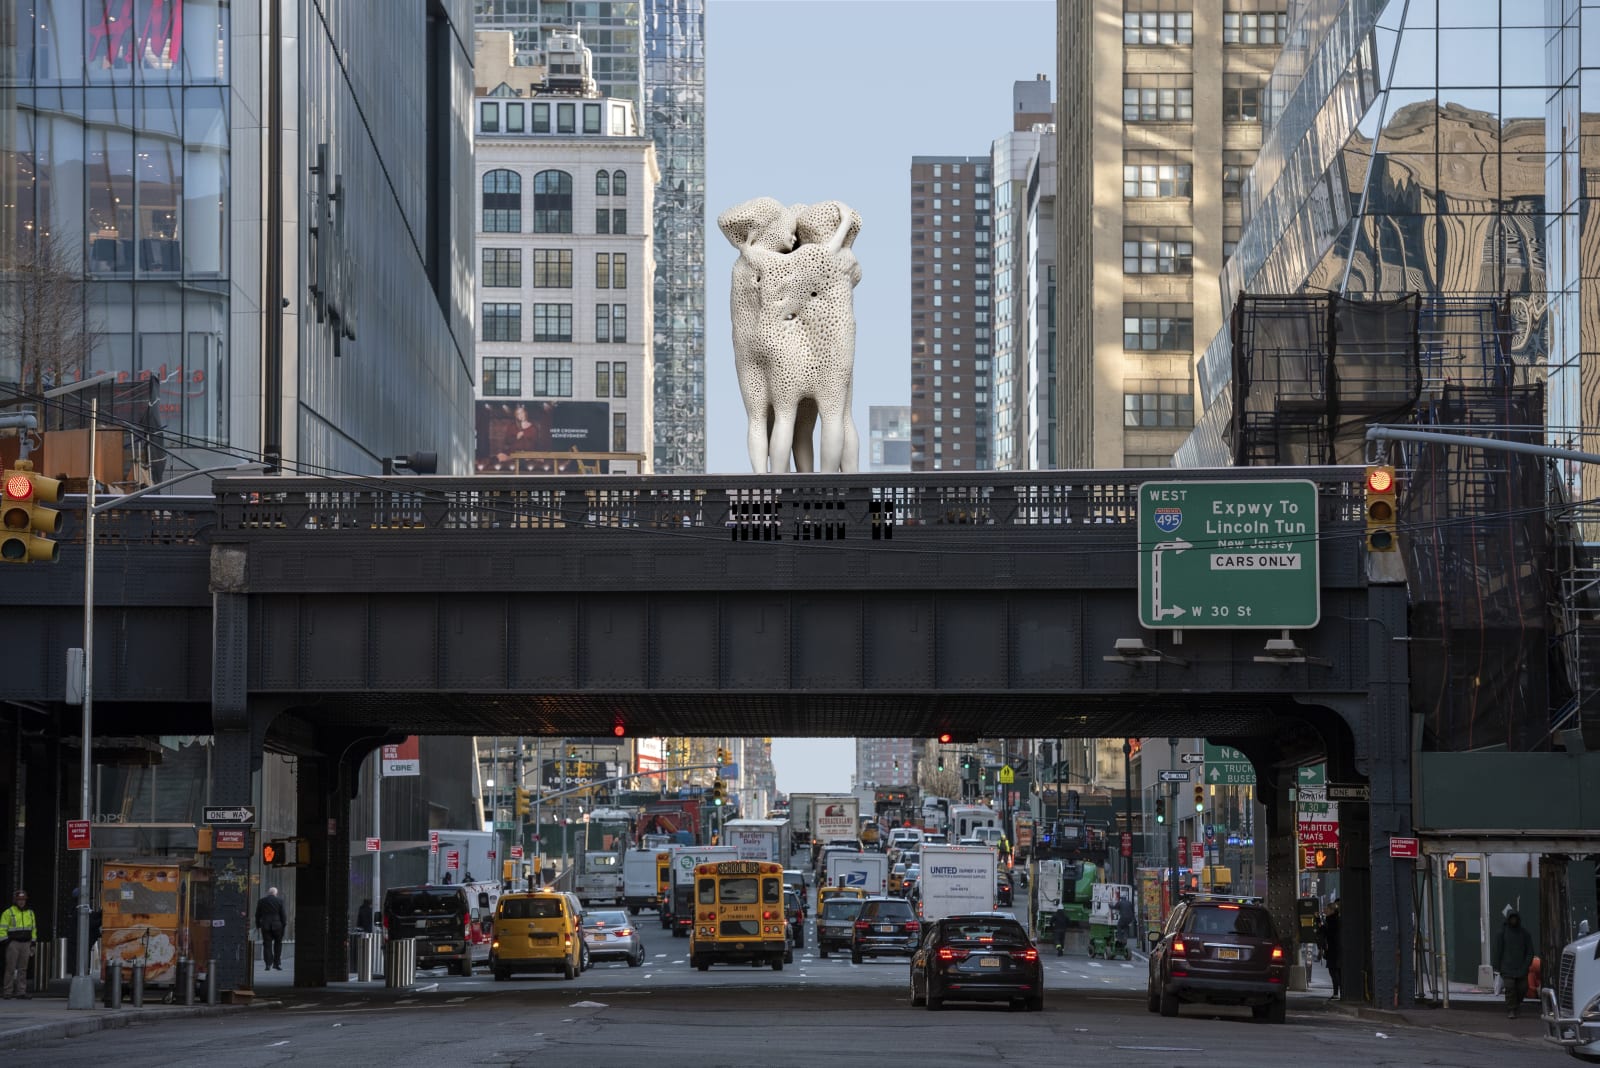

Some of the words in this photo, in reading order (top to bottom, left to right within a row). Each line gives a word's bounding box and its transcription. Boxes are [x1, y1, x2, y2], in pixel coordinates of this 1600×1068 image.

[1150, 491, 1187, 500] WEST
[1213, 501, 1272, 517] Expwy
[1280, 501, 1298, 513] To
[1157, 514, 1179, 525] 495
[1207, 520, 1268, 534] Lincoln
[1275, 520, 1306, 534] Tun
[1218, 539, 1244, 549] New
[1250, 539, 1293, 551] Jersey
[1216, 556, 1254, 567] CARS
[1259, 556, 1295, 567] ONLY
[1192, 606, 1202, 617] W
[1211, 606, 1229, 617] 30
[1237, 606, 1252, 617] St
[1224, 765, 1256, 773] TRUCK
[1228, 775, 1256, 783] BUSES
[1334, 788, 1349, 796] ONE
[1308, 803, 1319, 811] 30
[211, 811, 226, 819] ONE
[232, 811, 248, 819] WAY
[718, 863, 742, 874] SCHOOL
[746, 863, 760, 874] BUS
[931, 866, 957, 874] UNITED
